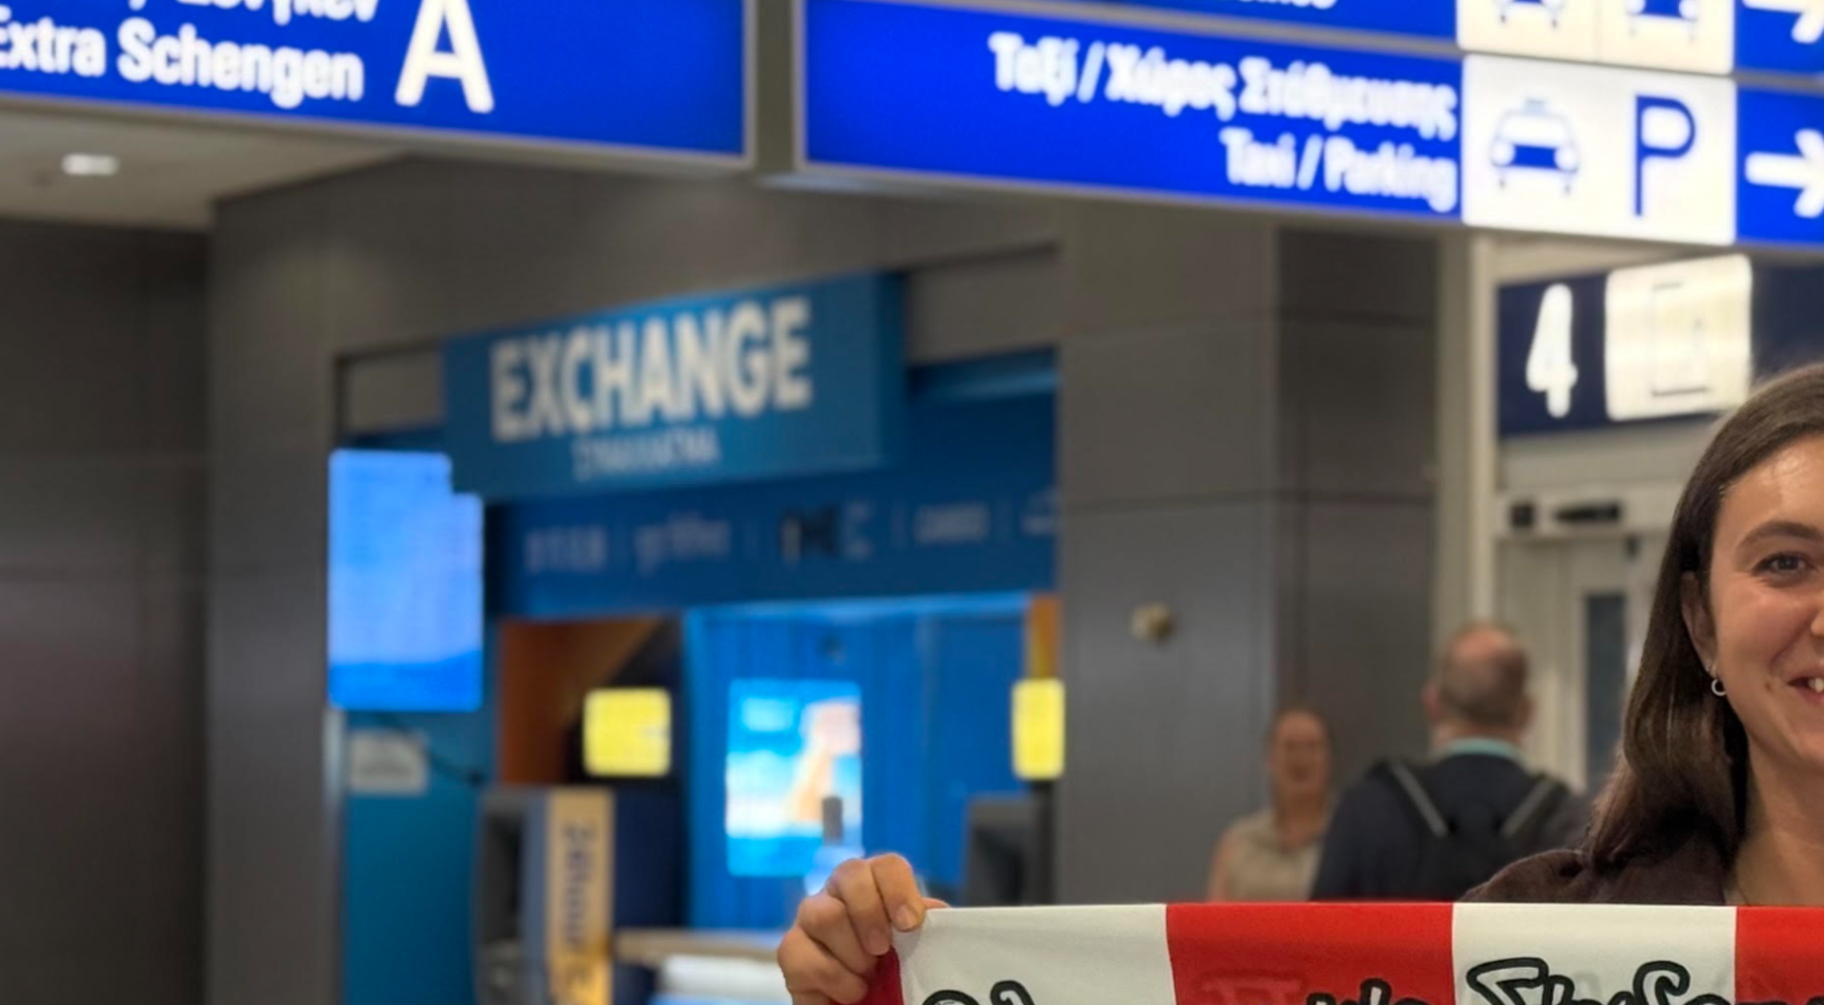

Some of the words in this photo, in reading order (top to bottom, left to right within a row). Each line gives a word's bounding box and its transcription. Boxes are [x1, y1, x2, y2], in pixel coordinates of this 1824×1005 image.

[117, 17, 364, 109] Schengen
[395, 0, 495, 113] A
[1632, 92, 1698, 217] P
[490, 297, 811, 442] EXCHANGE
[1526, 283, 1577, 419] 4
